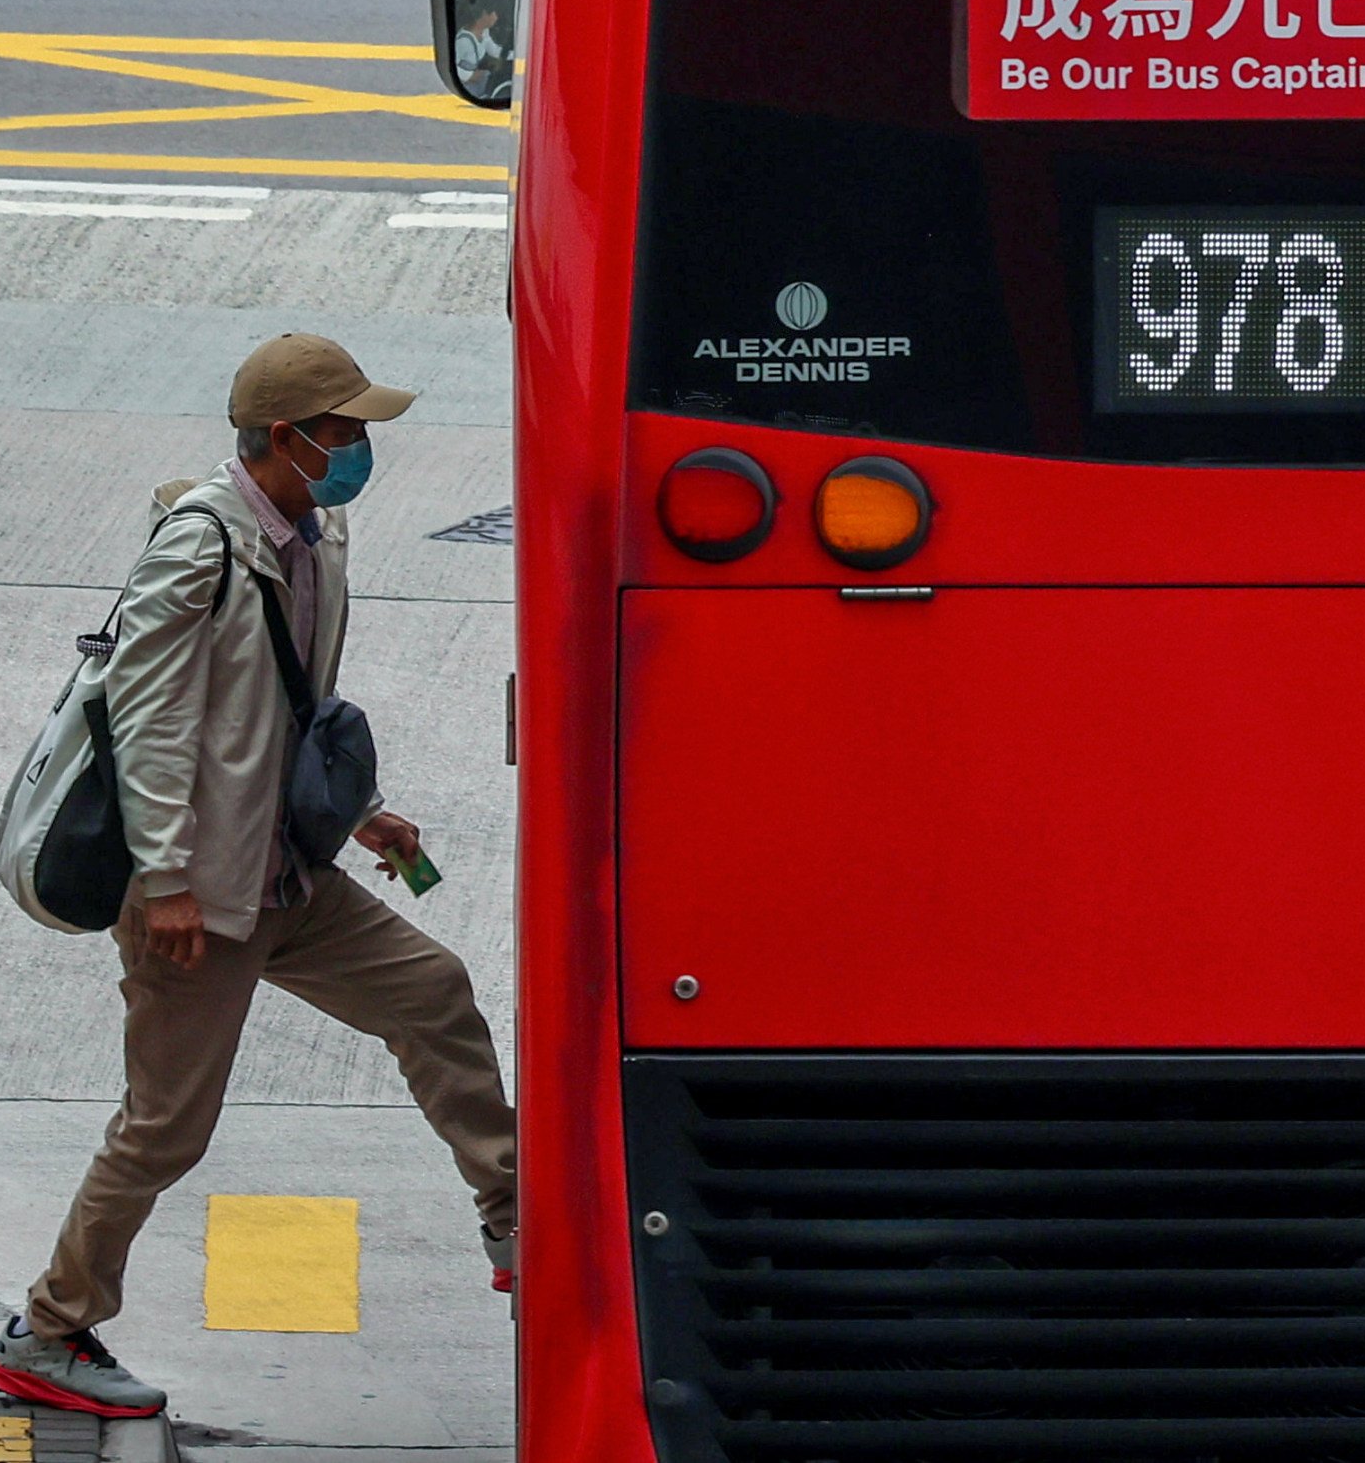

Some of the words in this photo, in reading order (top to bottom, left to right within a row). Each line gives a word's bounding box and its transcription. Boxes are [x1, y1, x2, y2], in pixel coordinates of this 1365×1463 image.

[1000, 56, 1050, 90] Be
[1061, 56, 1133, 91] Our
[1148, 56, 1219, 91] Bus
[1128, 232, 1347, 393] 978
[693, 336, 912, 360] ALEXANDER
[736, 361, 871, 383] DENNIS
